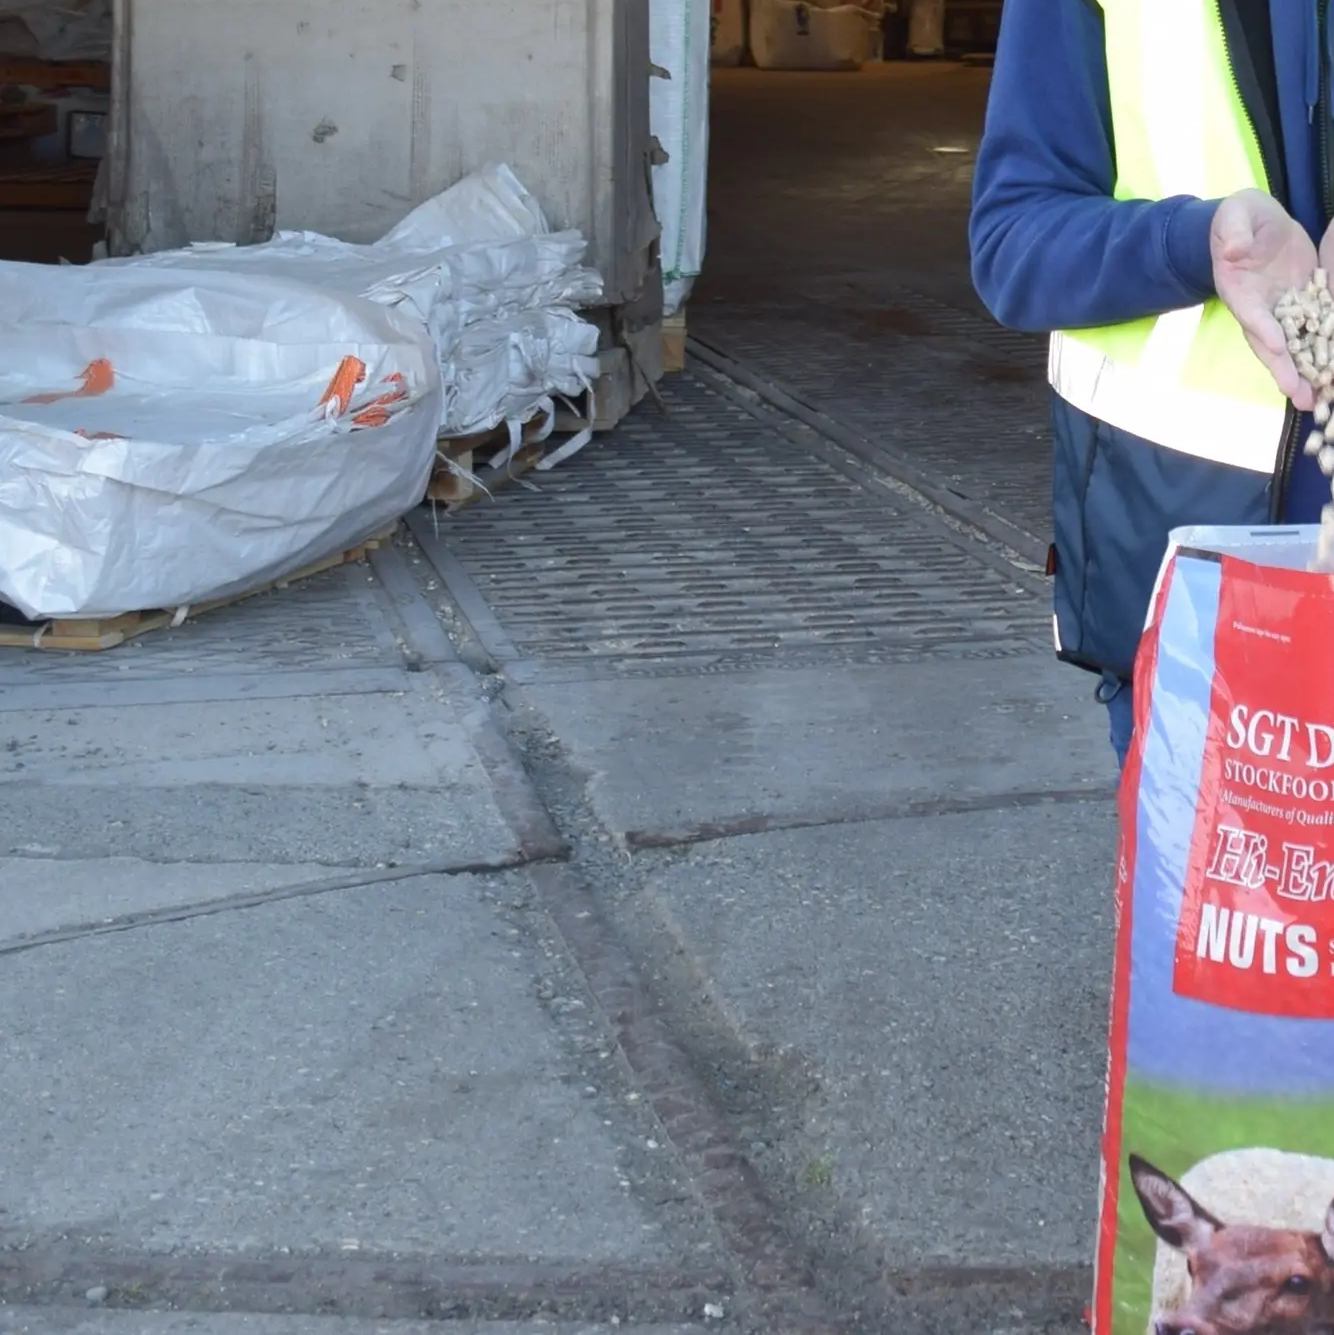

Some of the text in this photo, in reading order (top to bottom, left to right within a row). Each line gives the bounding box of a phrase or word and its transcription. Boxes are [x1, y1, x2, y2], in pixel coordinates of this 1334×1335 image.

[1226, 704, 1300, 762] SGT
[1220, 789, 1285, 819] Manufacturers
[1285, 808, 1298, 825] of
[1196, 903, 1319, 978] NUTS
